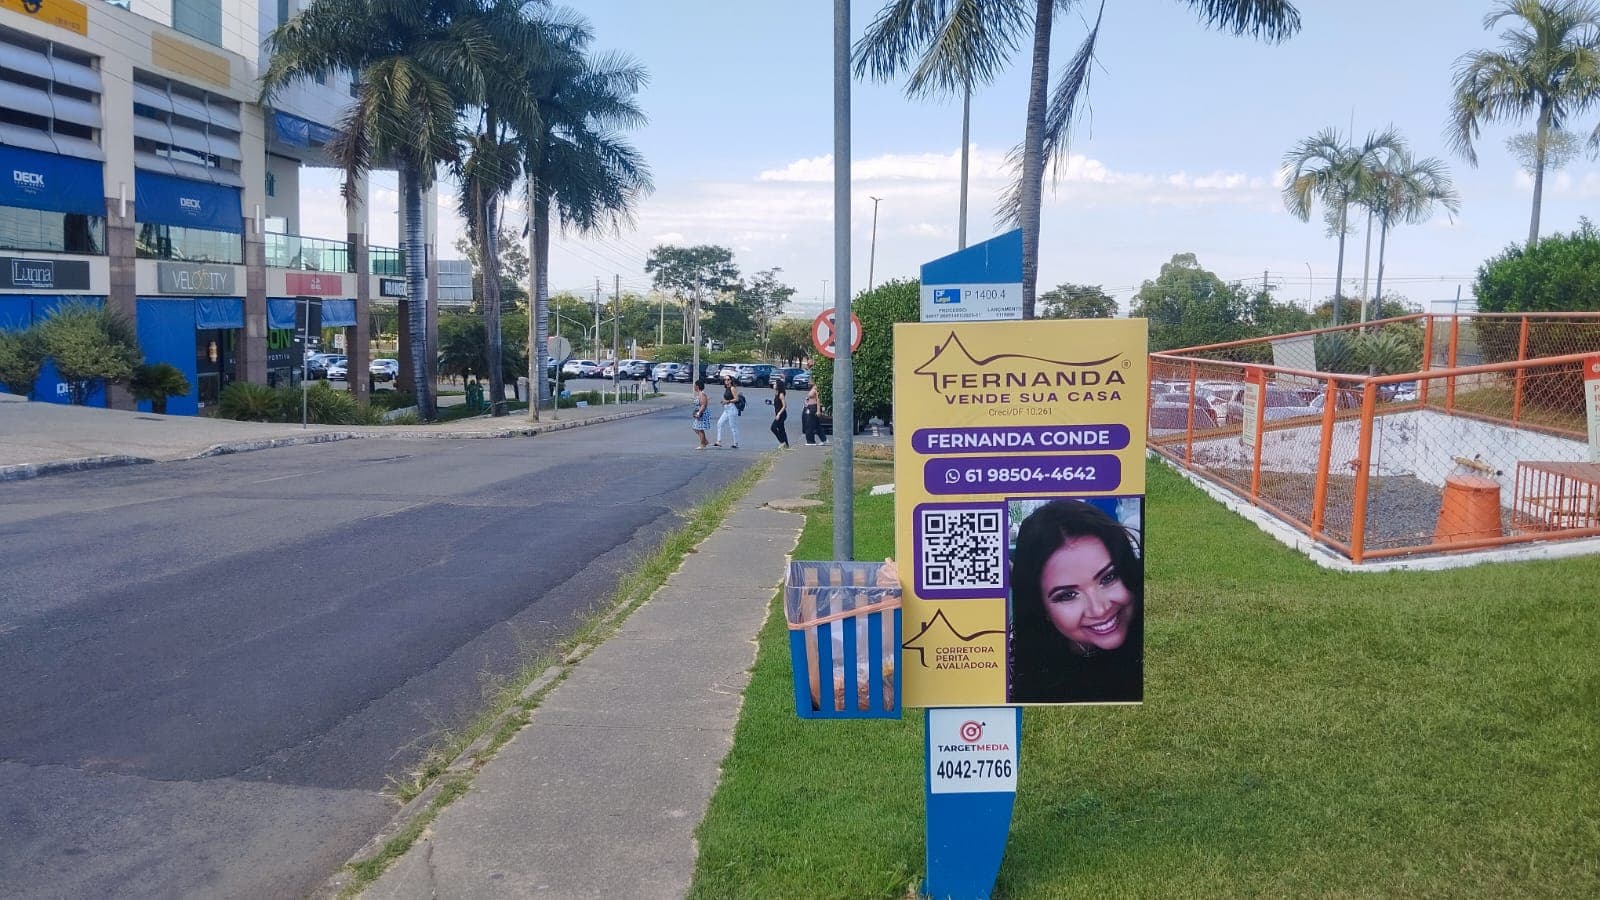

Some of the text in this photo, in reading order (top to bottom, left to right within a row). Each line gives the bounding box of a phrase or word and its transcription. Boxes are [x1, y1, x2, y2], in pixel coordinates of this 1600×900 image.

[13, 170, 45, 185] DECK
[180, 197, 201, 208] DECK
[172, 270, 228, 290] VELOCITY
[964, 289, 1006, 300] P 1400.4
[942, 370, 1126, 389] FERNANDA
[945, 390, 1122, 405] VENDE SUA CASA
[988, 408, 1024, 417] Creci/DF
[927, 430, 1110, 449] FERNANDA CONDE
[965, 466, 1096, 483] 61 98504-4642
[936, 646, 995, 655] CORRETORA
[936, 654, 970, 662] PERITA
[936, 661, 999, 670] AVALIADORA
[938, 744, 1010, 753] TARGETMEDIA
[936, 759, 1012, 780] 4042-7766
